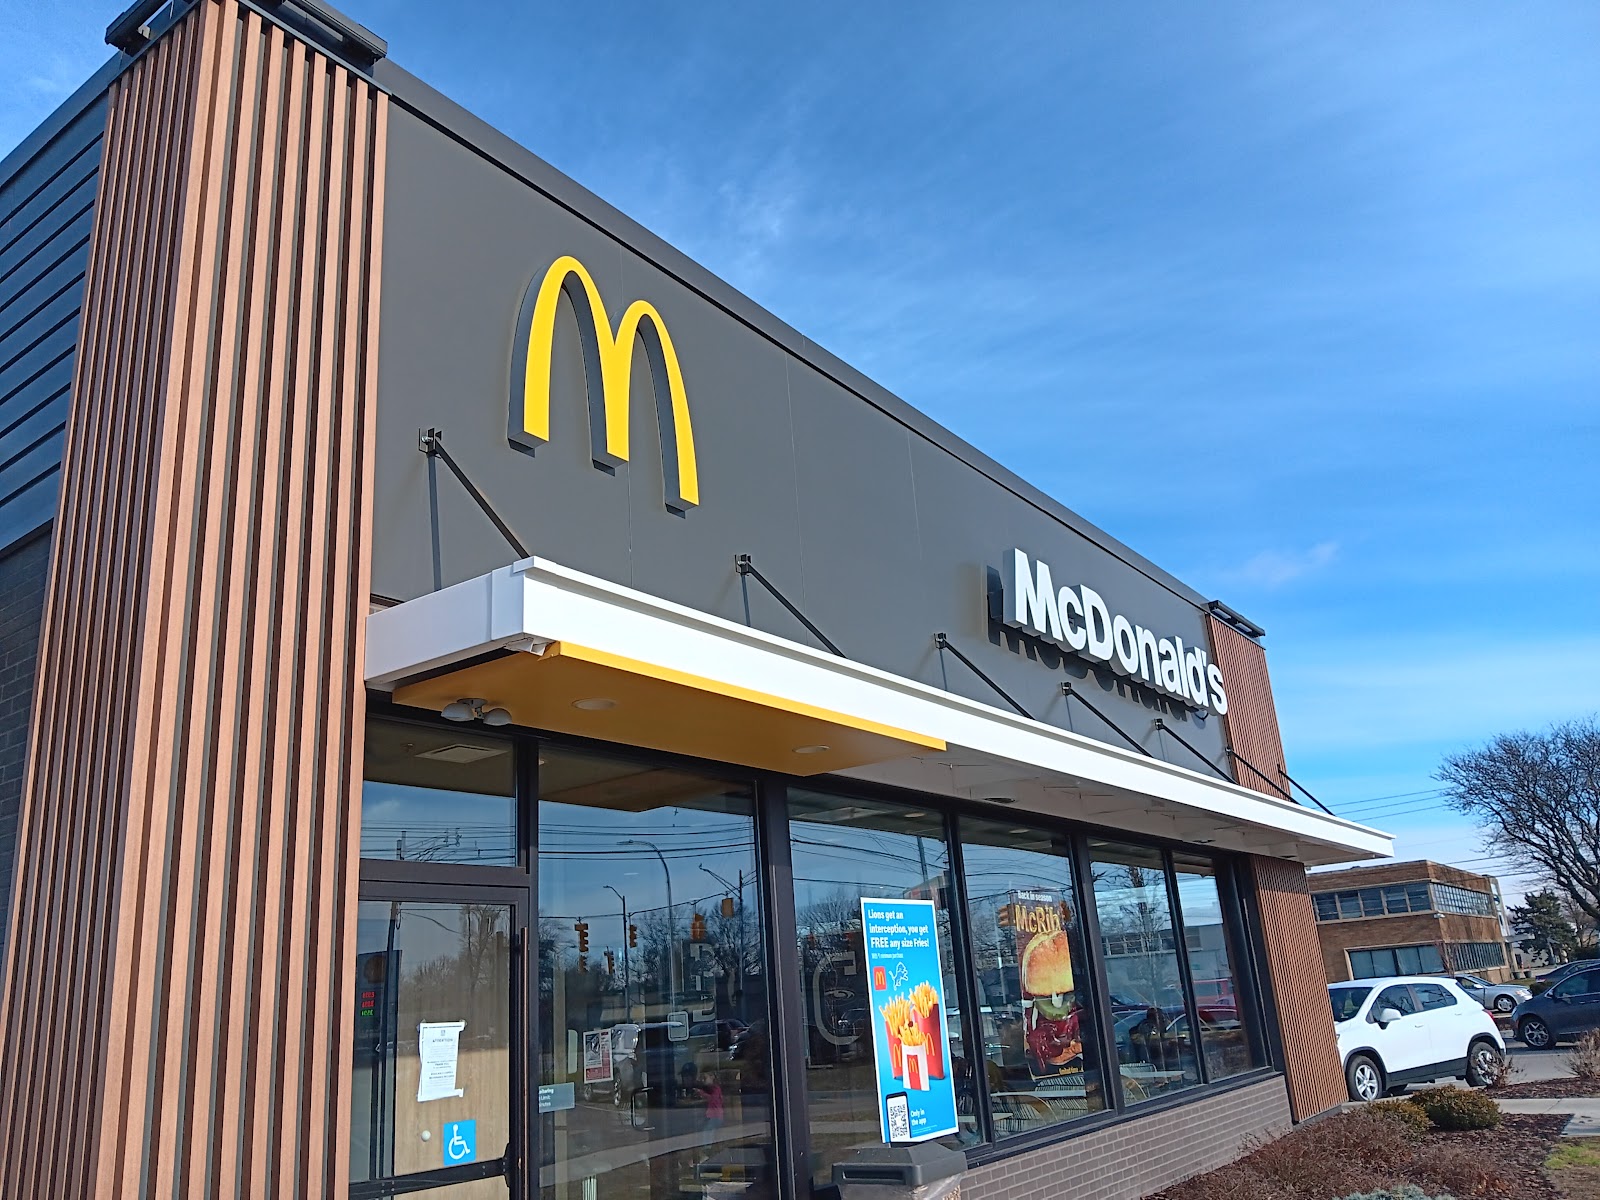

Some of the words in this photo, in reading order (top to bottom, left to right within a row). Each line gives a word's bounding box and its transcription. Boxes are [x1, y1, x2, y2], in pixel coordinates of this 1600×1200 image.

[1012, 547, 1228, 716] McDonald's
[1035, 893, 1053, 902] season
[868, 908, 885, 919] Lions
[885, 910, 896, 921] get
[896, 911, 903, 919] an
[1015, 904, 1062, 932] McRib
[869, 923, 907, 935] interception,
[908, 926, 918, 935] you
[919, 925, 928, 935] get
[871, 937, 889, 948] FREE
[890, 940, 900, 950] any
[901, 937, 913, 948] size
[913, 937, 929, 947] Fries!
[911, 1109, 920, 1118] Only
